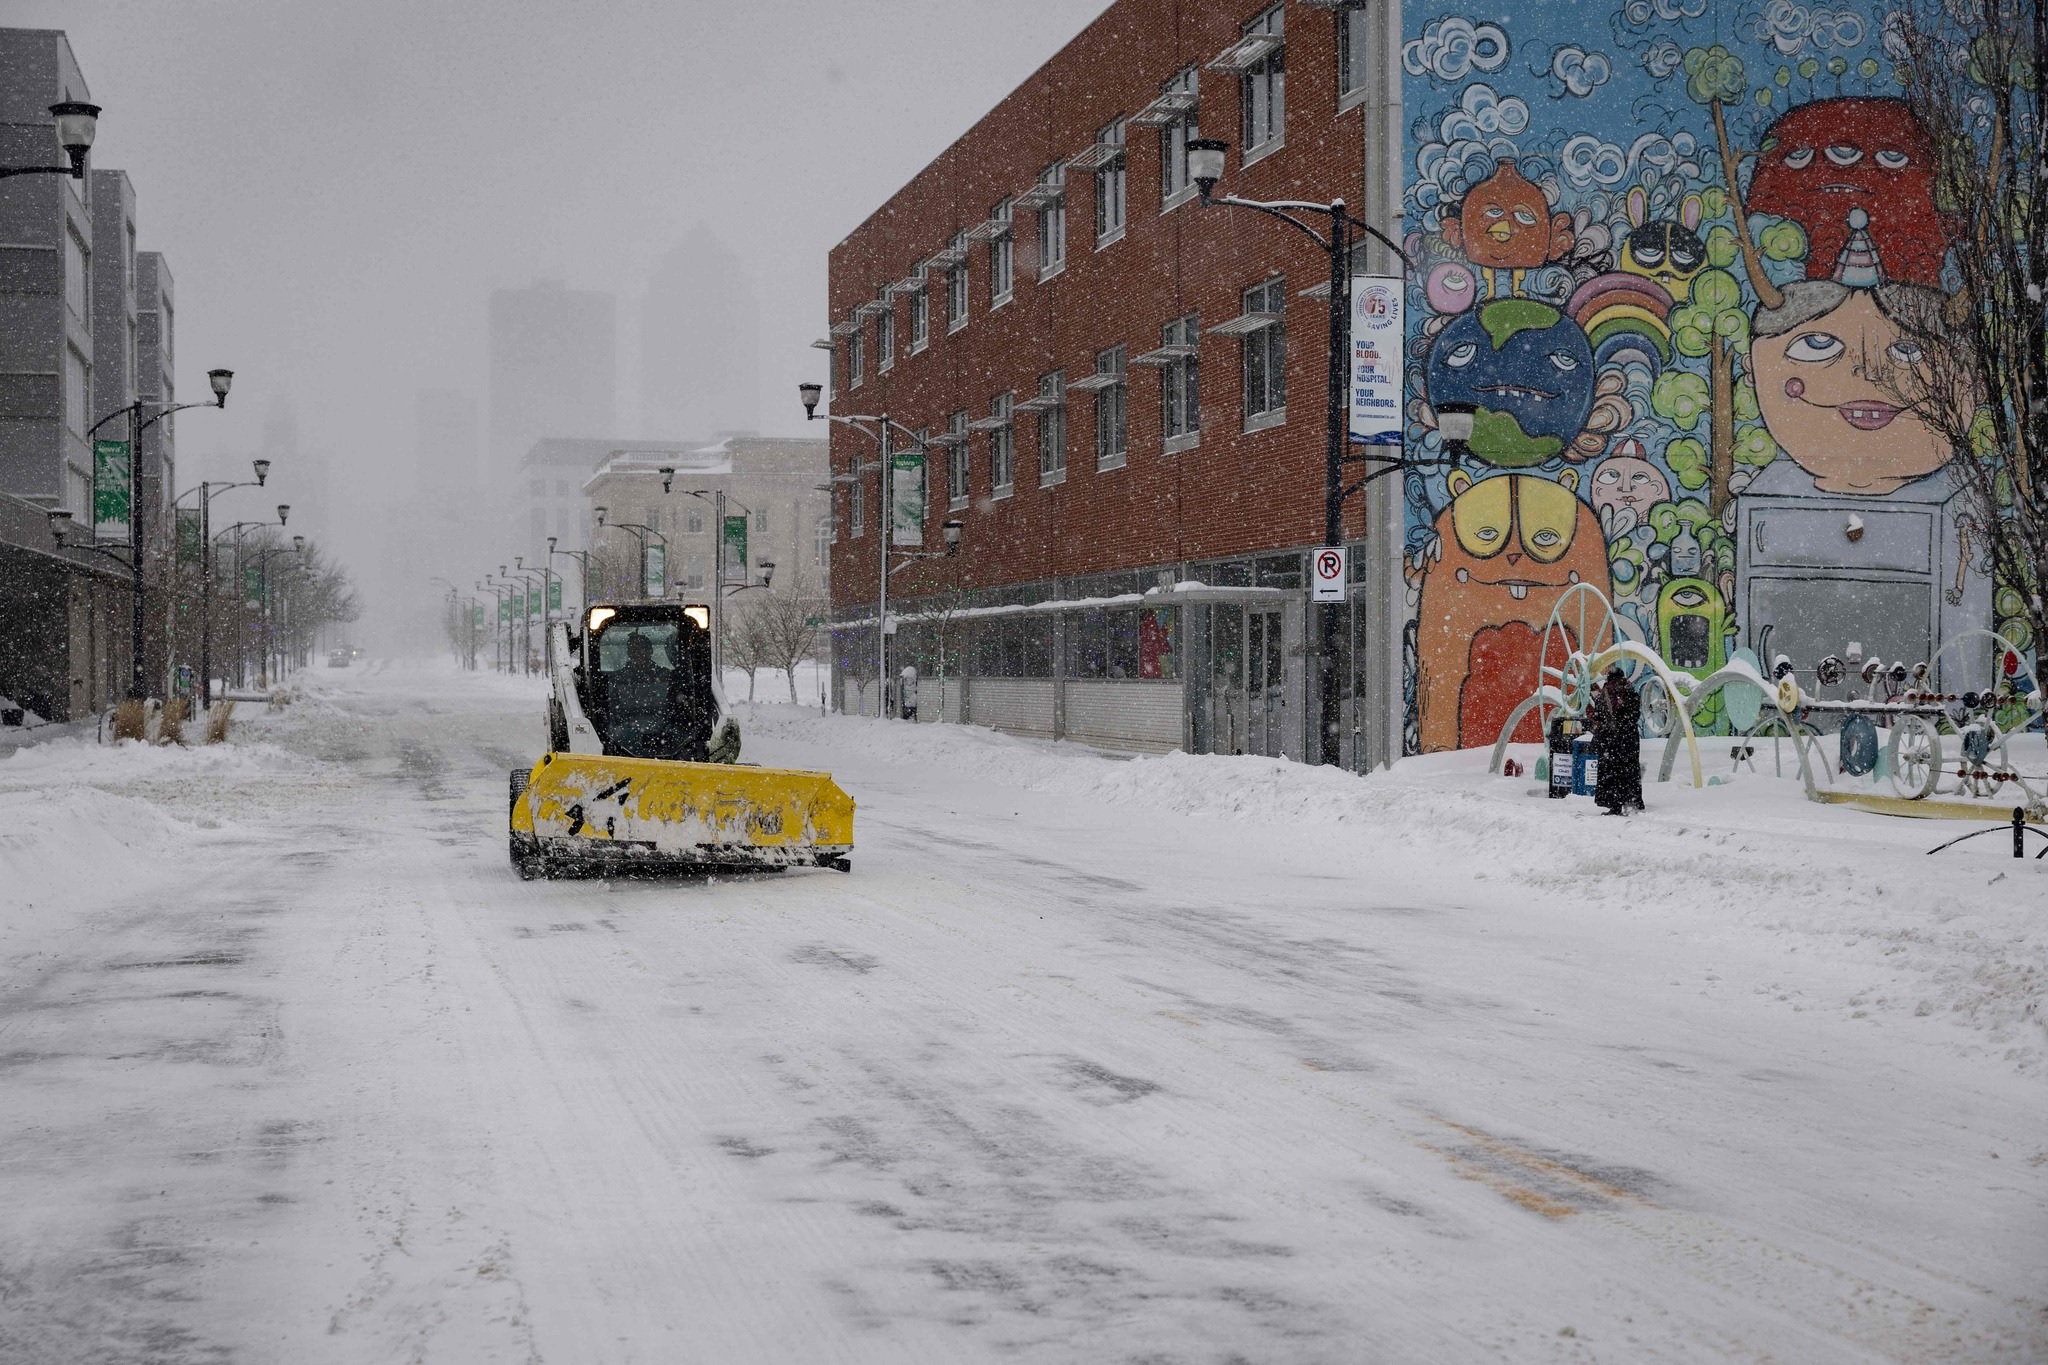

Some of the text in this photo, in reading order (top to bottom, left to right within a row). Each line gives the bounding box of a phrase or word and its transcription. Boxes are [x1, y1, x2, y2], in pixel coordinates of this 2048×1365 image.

[1369, 298, 1386, 314] 75
[1366, 319, 1393, 330] SAVING
[1355, 349, 1382, 359] BLOOD.
[1357, 365, 1375, 374] YOUR
[1356, 374, 1391, 384] HOSPITAL.
[1355, 388, 1375, 398] YOUR
[1355, 398, 1397, 408] NEIGHBORS.
[1324, 556, 1337, 573] P
